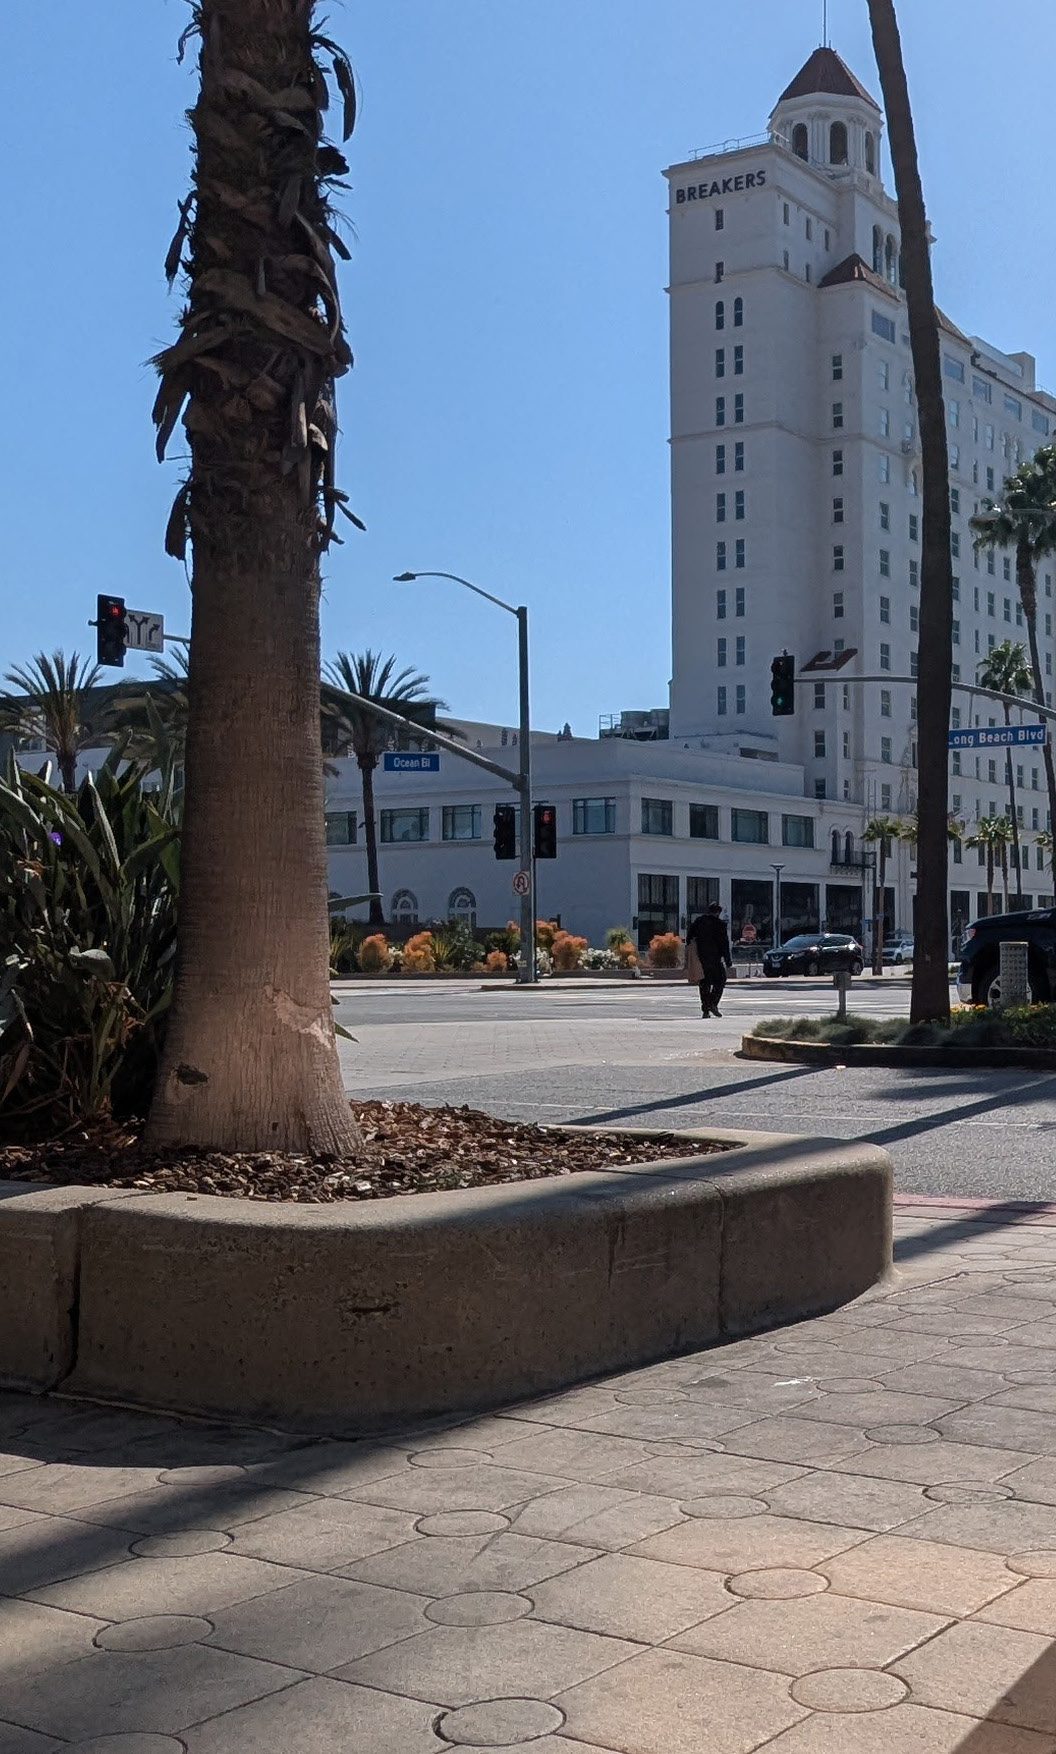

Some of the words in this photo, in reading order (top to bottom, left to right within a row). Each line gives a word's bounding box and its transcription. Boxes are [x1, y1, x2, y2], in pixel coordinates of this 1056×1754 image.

[676, 170, 766, 204] BREAKERS
[949, 734, 974, 747] ong
[979, 731, 1013, 744] Beach
[1018, 729, 1044, 741] Blvd
[394, 757, 420, 768] Ocean
